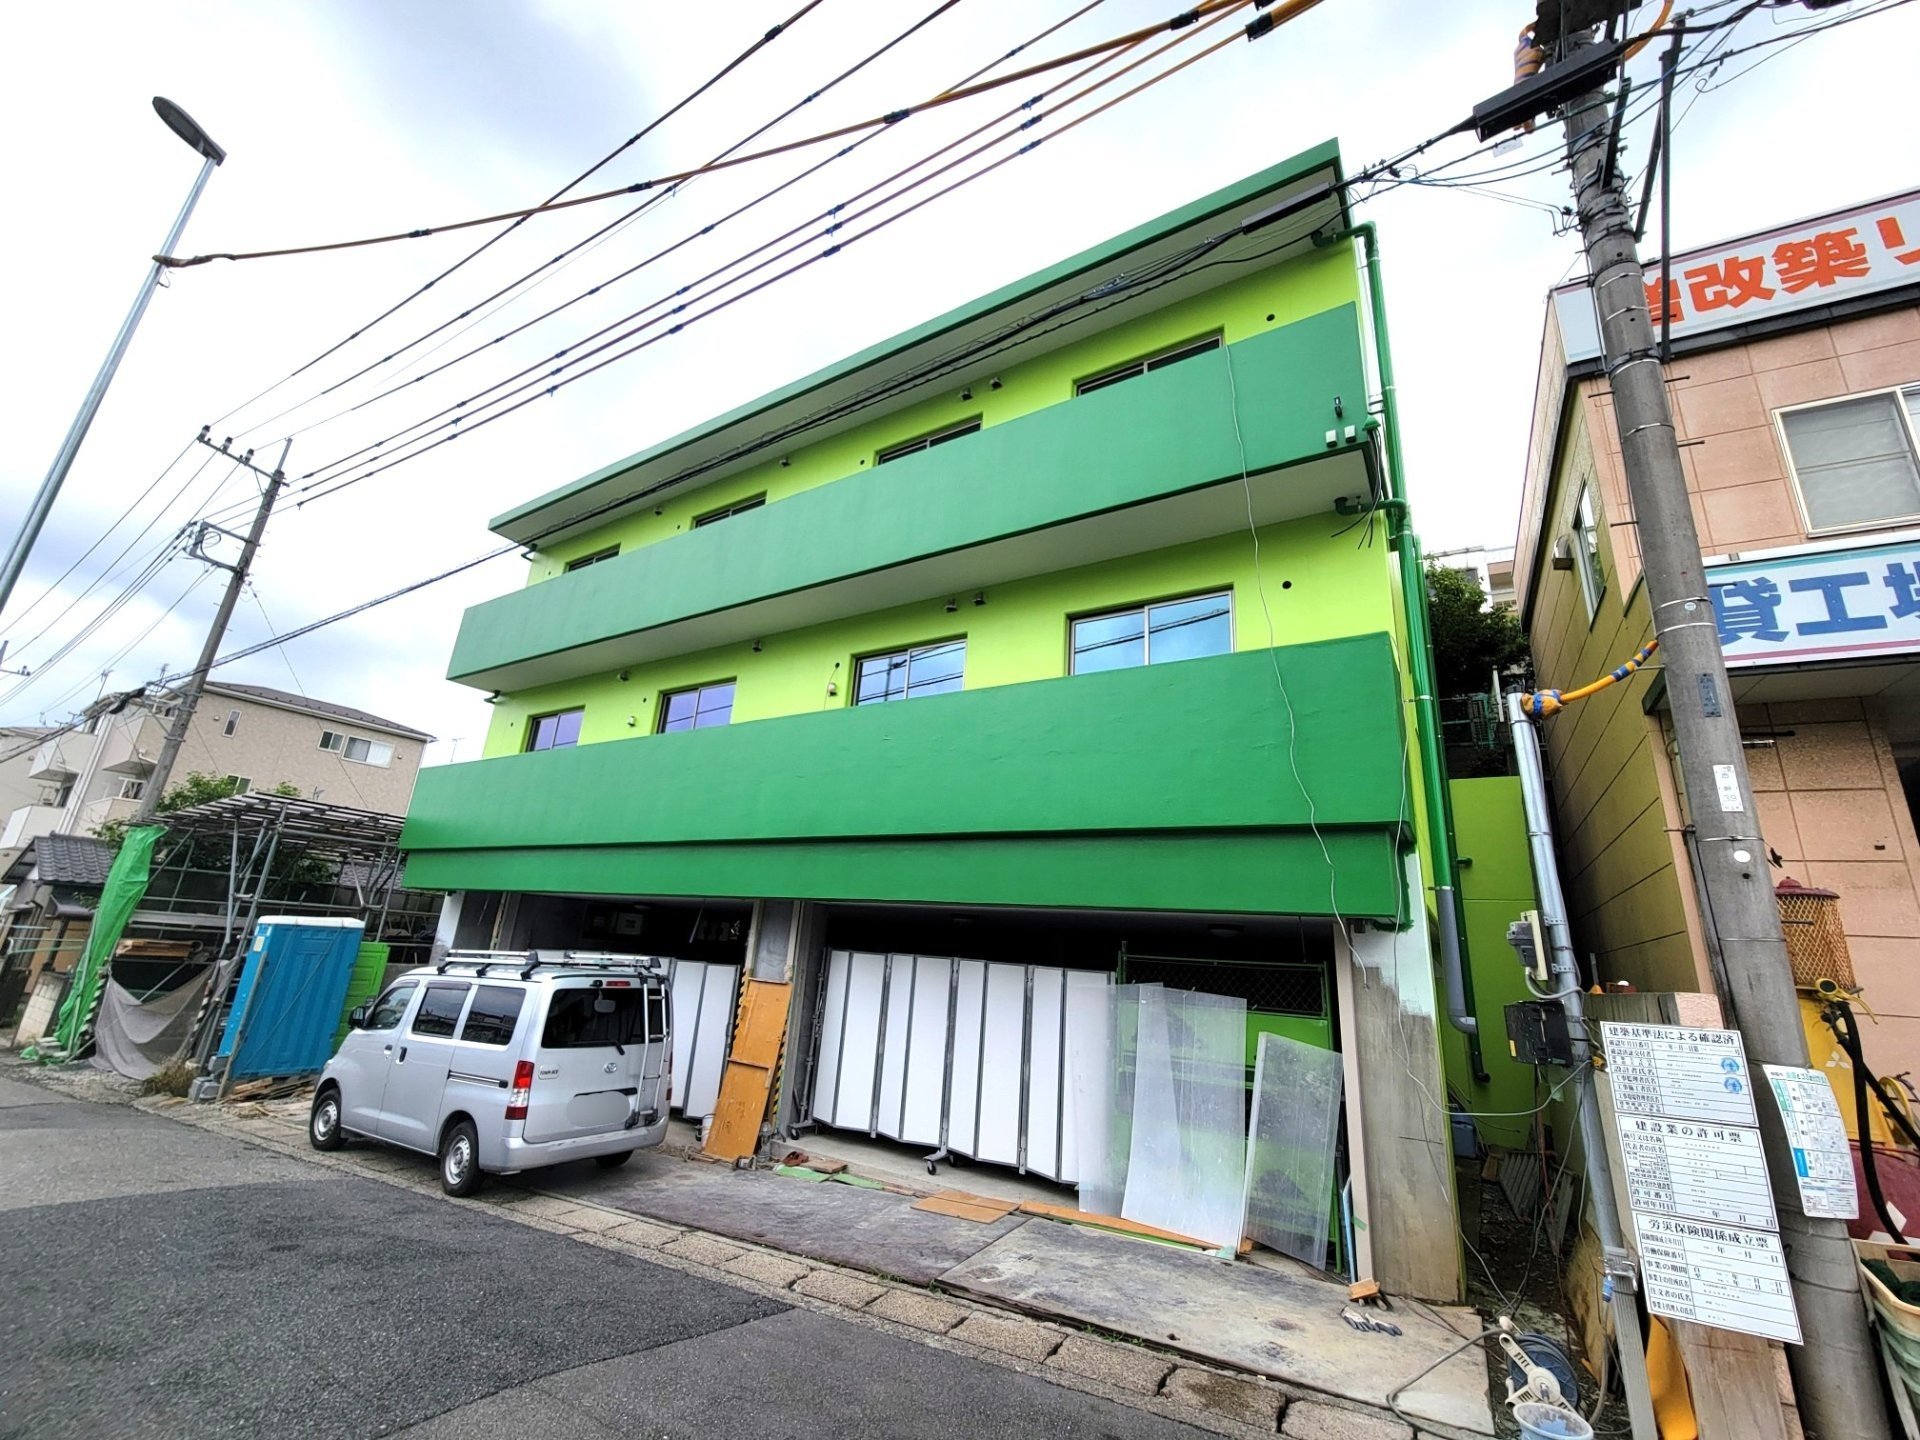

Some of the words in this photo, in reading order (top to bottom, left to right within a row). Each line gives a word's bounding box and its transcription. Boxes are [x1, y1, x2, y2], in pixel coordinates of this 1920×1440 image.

[1609, 1026, 1734, 1045] 建築基準法による確認済
[1635, 1120, 1742, 1143] 建設業の許可票
[1649, 1219, 1769, 1248] 労災保険関係成立票
